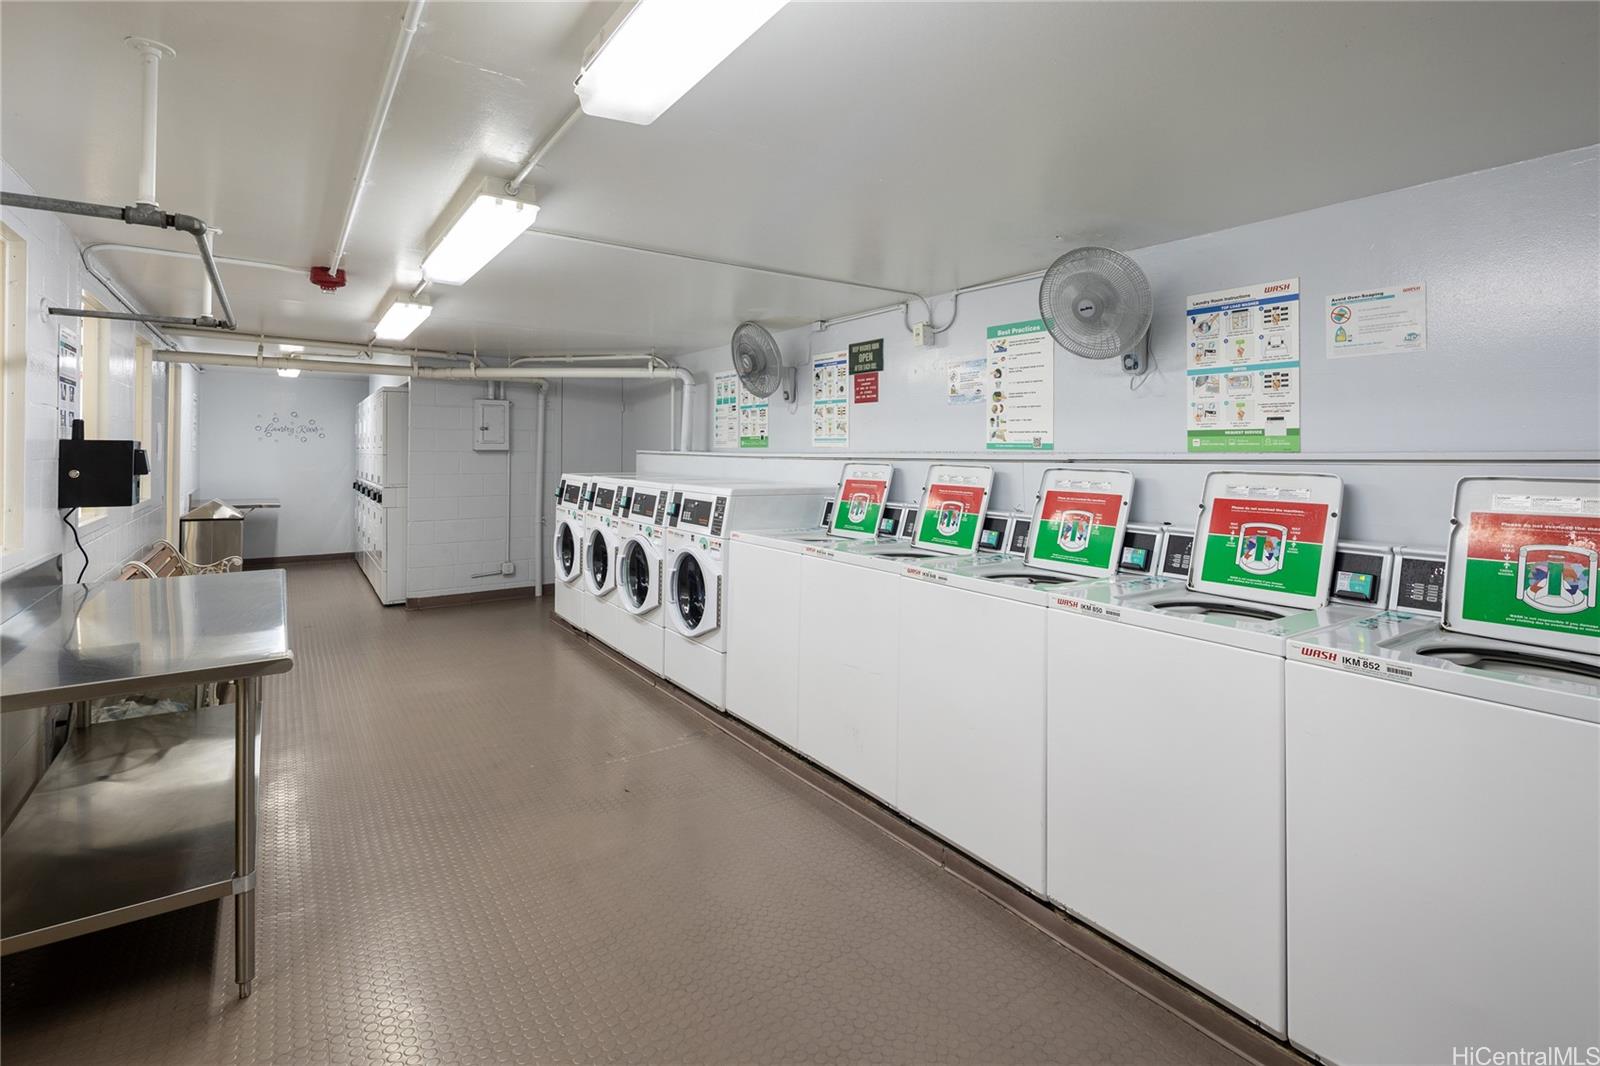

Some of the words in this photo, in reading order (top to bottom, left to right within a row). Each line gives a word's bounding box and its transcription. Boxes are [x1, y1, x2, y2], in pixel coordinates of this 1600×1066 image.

[1264, 283, 1290, 294] WASH
[1347, 292, 1384, 300] Over-Soaping
[997, 329, 1011, 337] Best
[1012, 325, 1041, 334] Practices
[1057, 598, 1078, 609] WASH
[1301, 647, 1338, 662] WASH
[1342, 656, 1360, 667] IKM
[1362, 660, 1381, 671] 852
